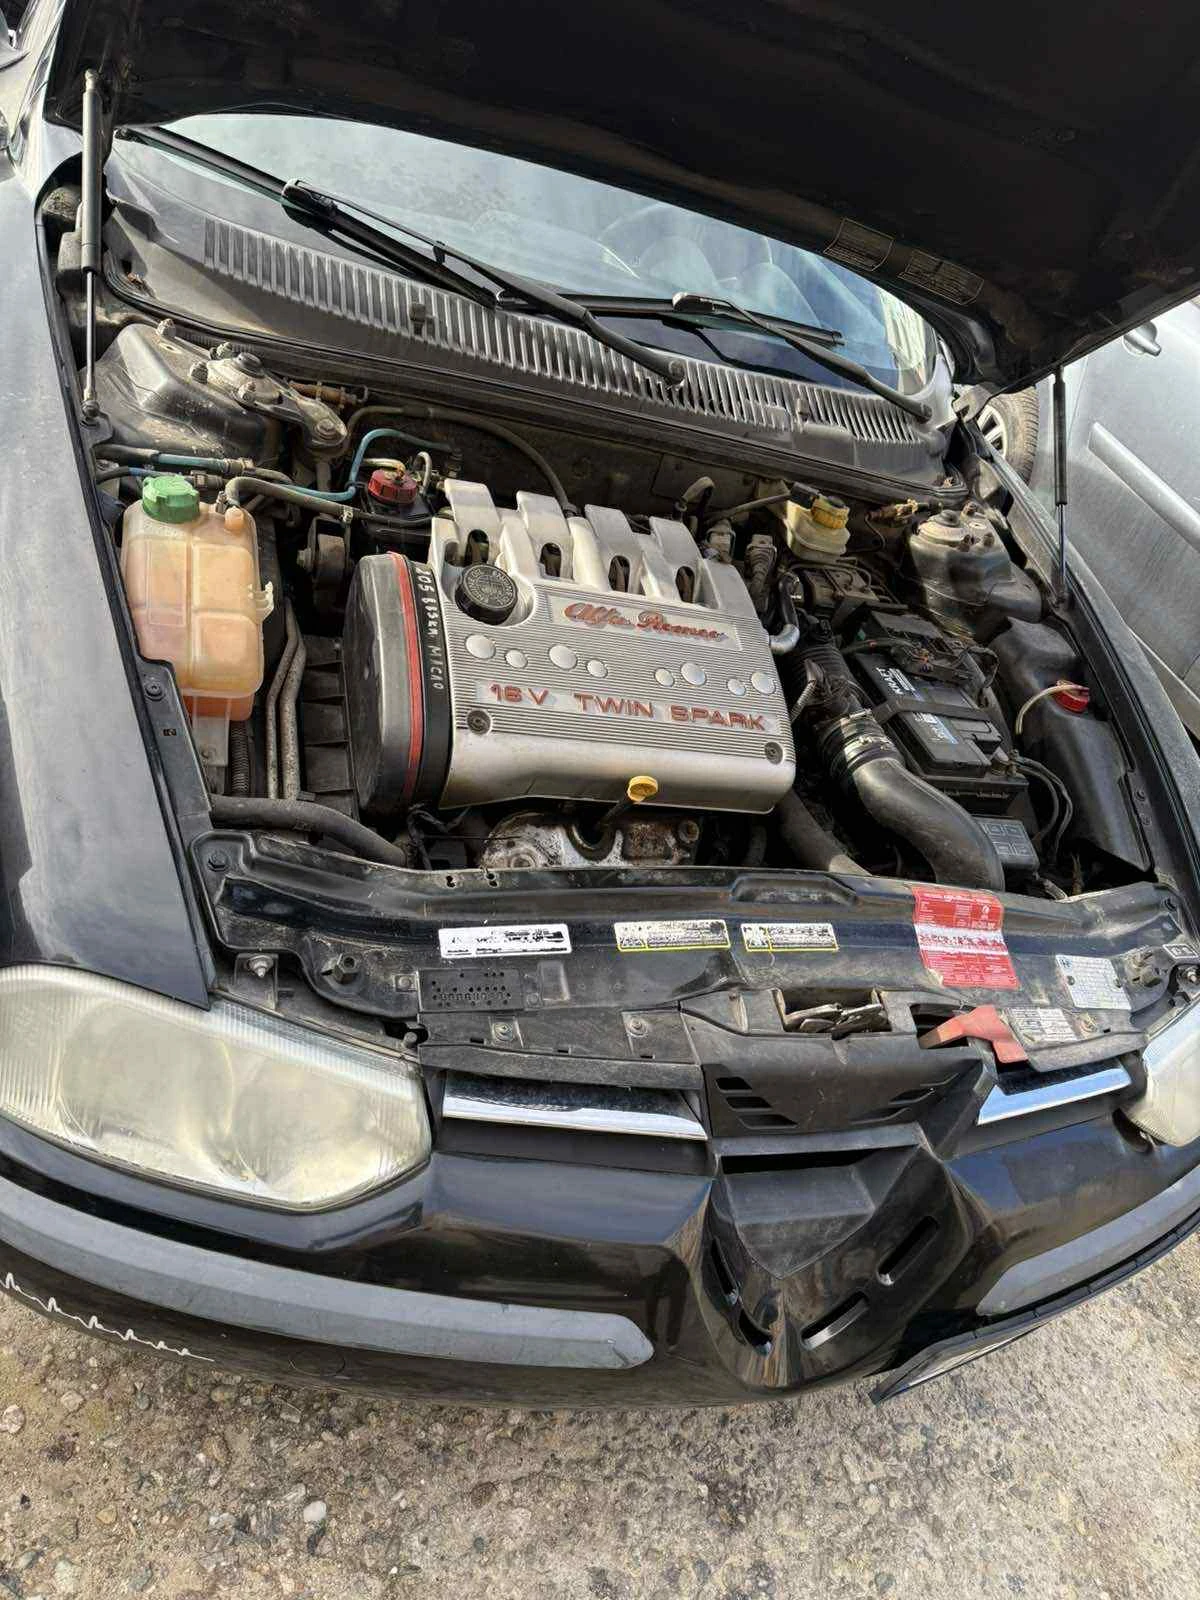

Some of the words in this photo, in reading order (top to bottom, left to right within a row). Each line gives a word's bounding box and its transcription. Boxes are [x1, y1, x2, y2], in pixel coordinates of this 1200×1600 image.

[563, 602, 632, 628] Alfa
[634, 611, 729, 642] Romeo
[573, 692, 656, 719] TWIN
[669, 704, 766, 731] SPARK
